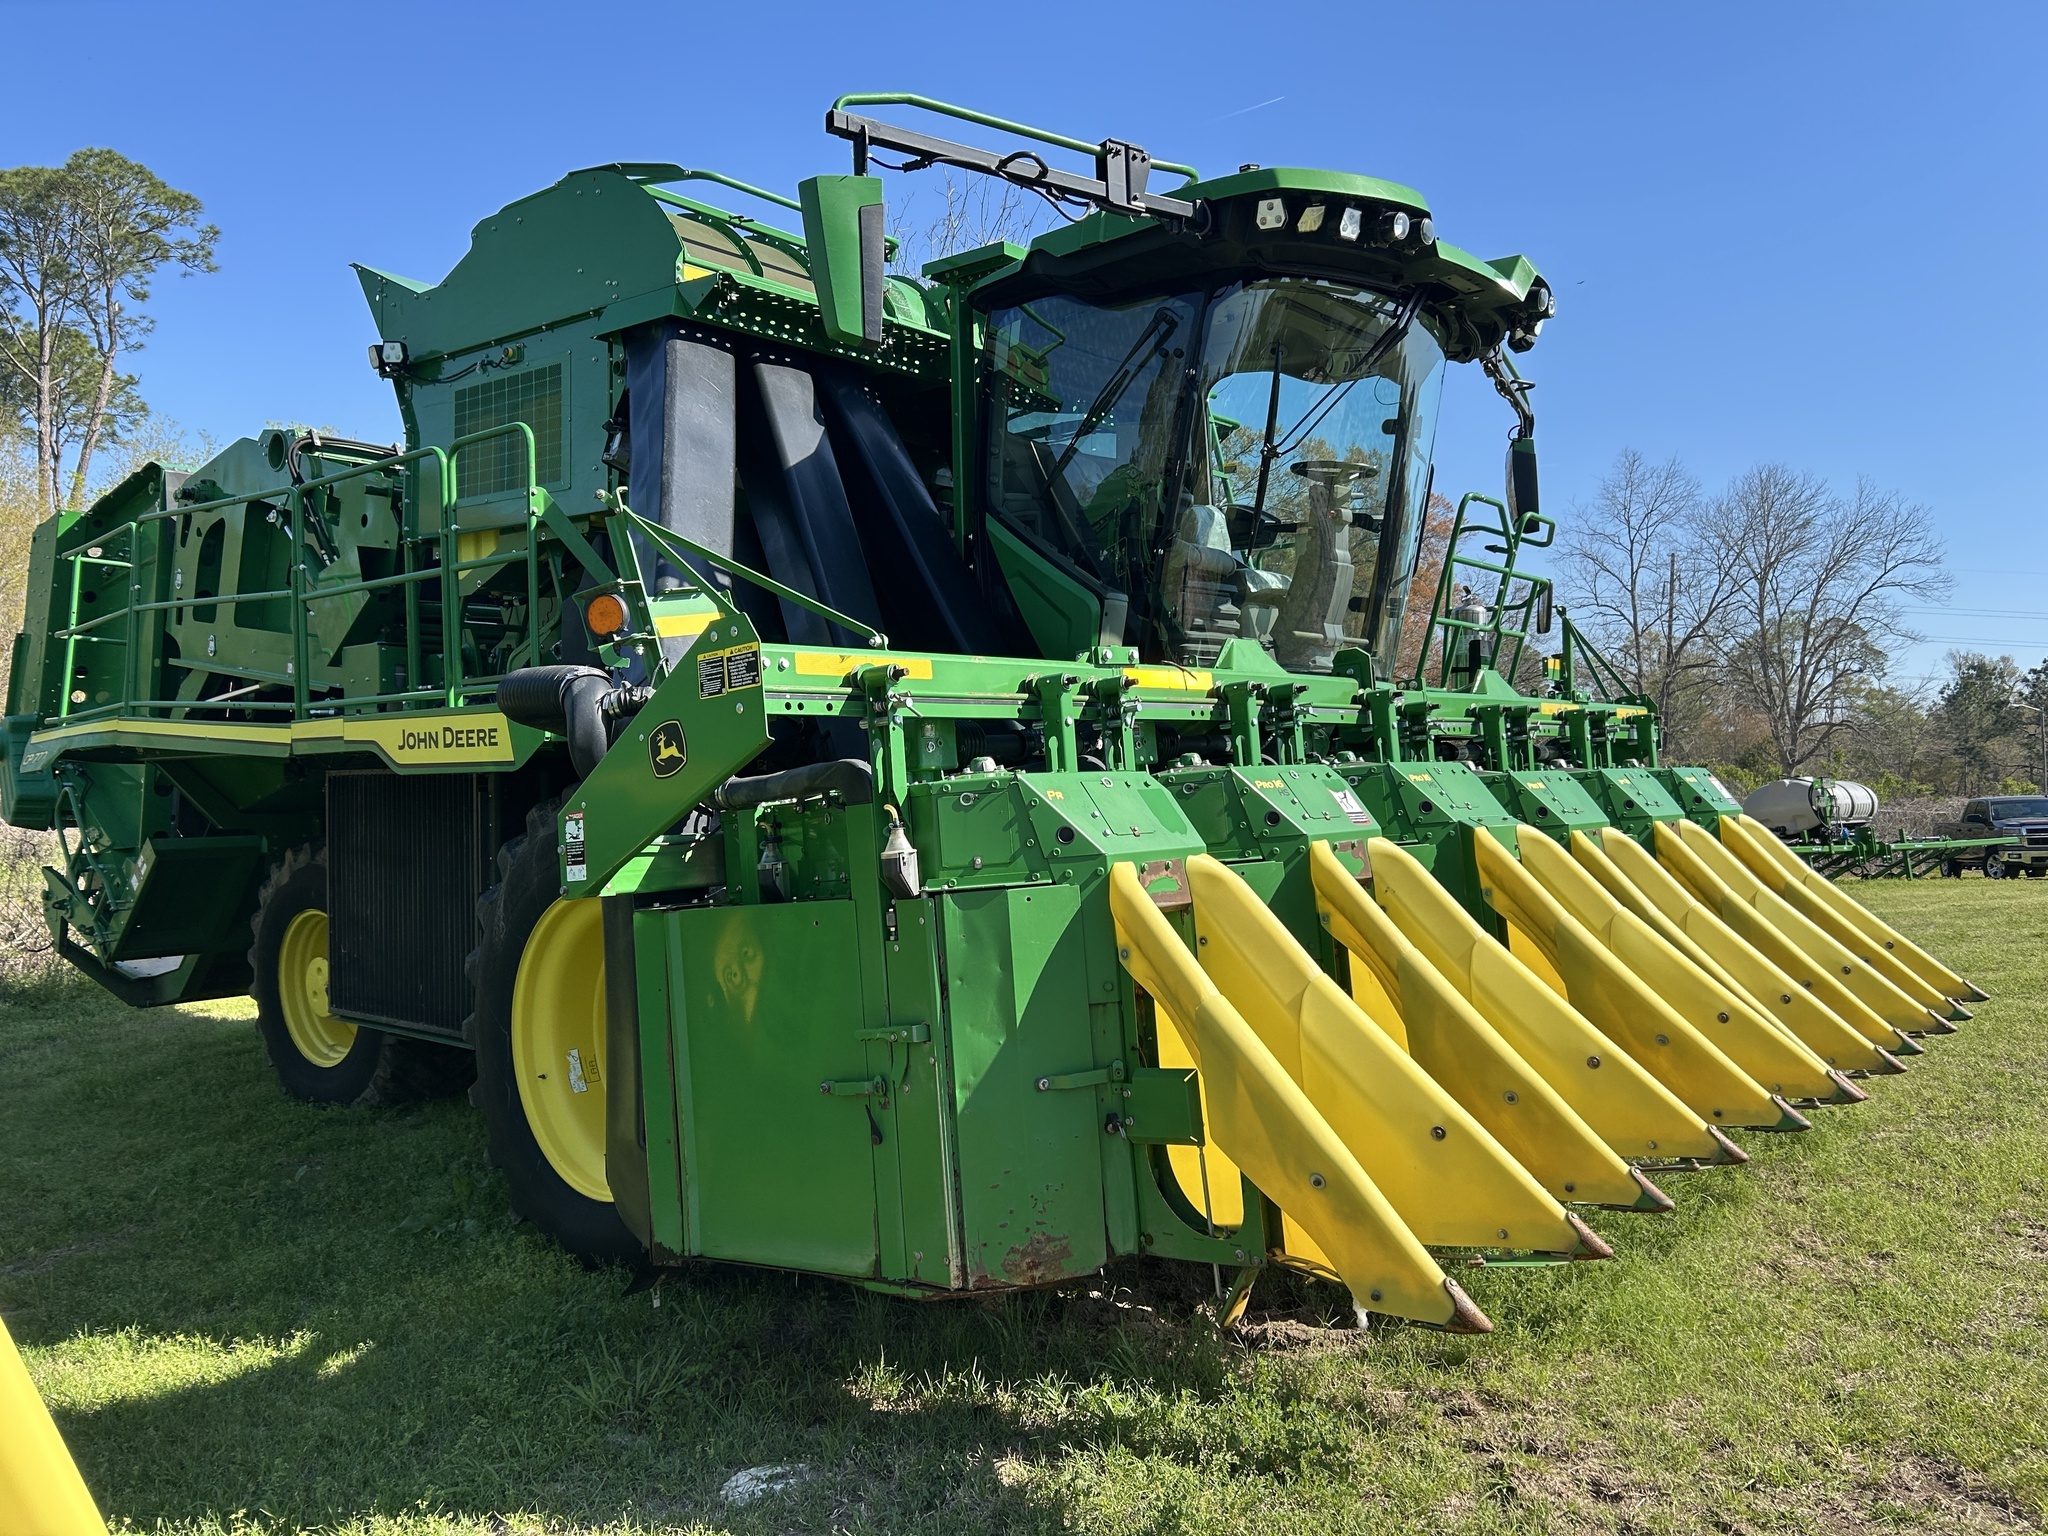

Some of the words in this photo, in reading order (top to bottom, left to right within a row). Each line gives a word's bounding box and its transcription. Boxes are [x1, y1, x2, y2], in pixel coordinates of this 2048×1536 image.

[735, 645, 753, 654] CAUTION
[398, 729, 439, 750] JOHN
[443, 727, 498, 748] DEERE
